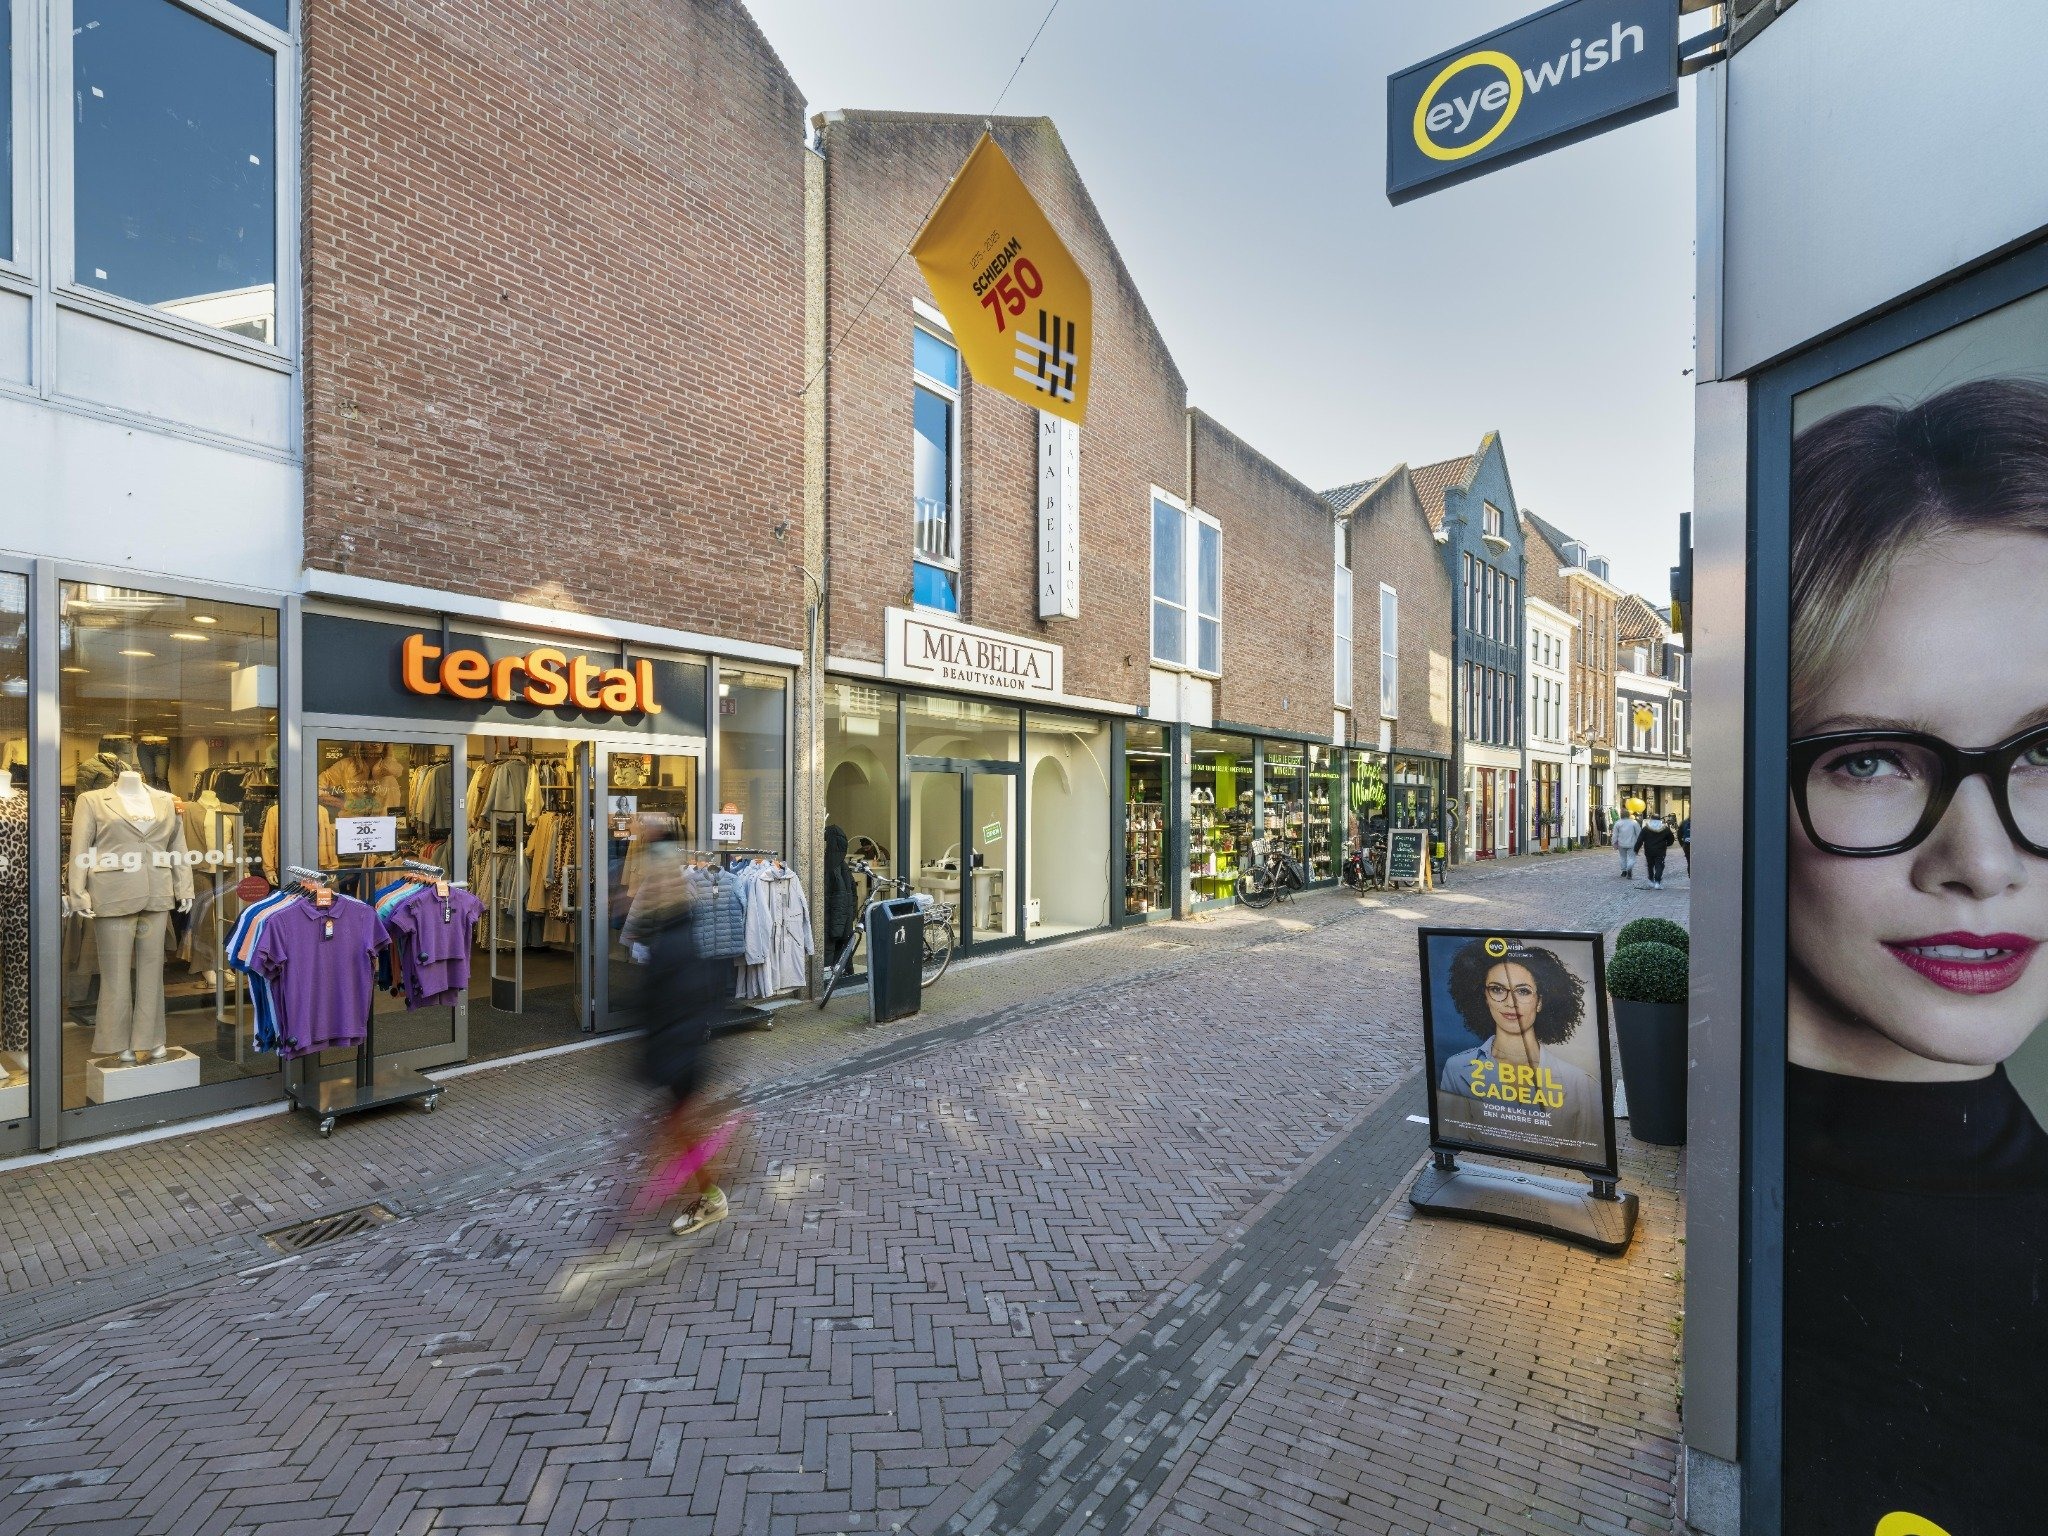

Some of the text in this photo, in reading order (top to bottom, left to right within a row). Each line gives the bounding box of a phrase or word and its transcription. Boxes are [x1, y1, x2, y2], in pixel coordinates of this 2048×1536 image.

[973, 236, 1022, 296] SCHIEDAM
[981, 257, 1043, 334] 750
[1044, 420, 1056, 597] MIA BELLA
[1066, 428, 1075, 610] EAUTYSALON
[922, 629, 1041, 679] MIA BELLA
[402, 633, 662, 715] terStal
[942, 666, 1025, 690] BEAUTYSALON
[719, 822, 736, 831] 20%
[75, 844, 262, 873] dag mooi...
[1498, 1062, 1563, 1090] BRIL
[1470, 1080, 1564, 1109] CADEAU
[1483, 1103, 1551, 1119] VOOR ELKE LOOK
[1483, 1110, 1552, 1127] EEN ANDERE BRIL
